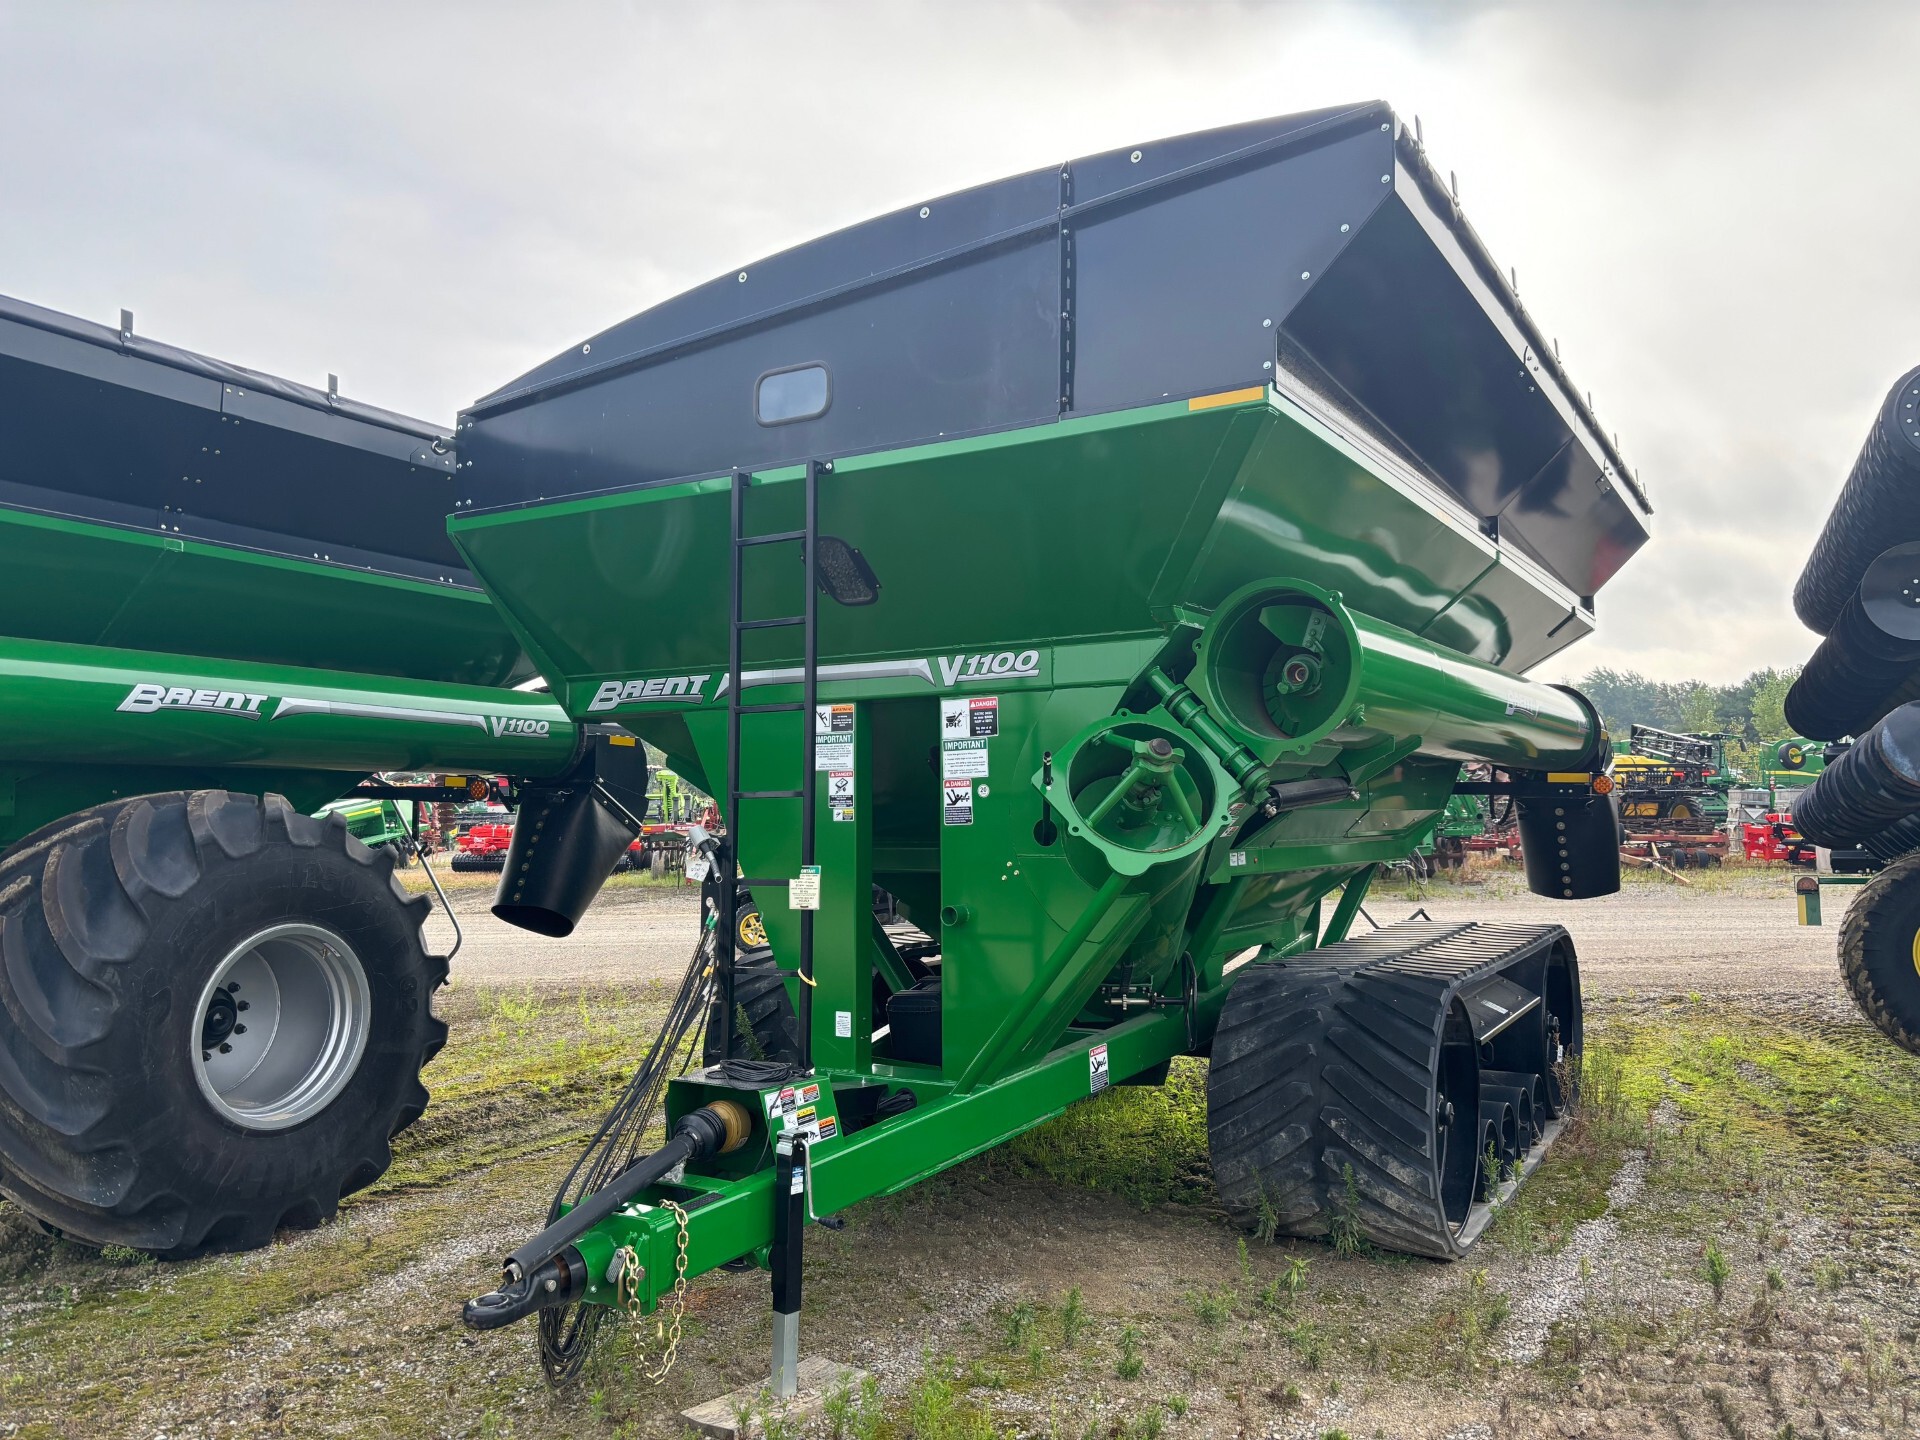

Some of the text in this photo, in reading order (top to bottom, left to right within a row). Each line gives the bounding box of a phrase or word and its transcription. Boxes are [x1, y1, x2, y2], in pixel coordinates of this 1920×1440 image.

[587, 650, 1040, 712] BRENT V1100
[115, 683, 550, 738] BRENT V1100
[816, 735, 852, 744] IMPORTANT
[944, 740, 986, 750] IMPORTANT
